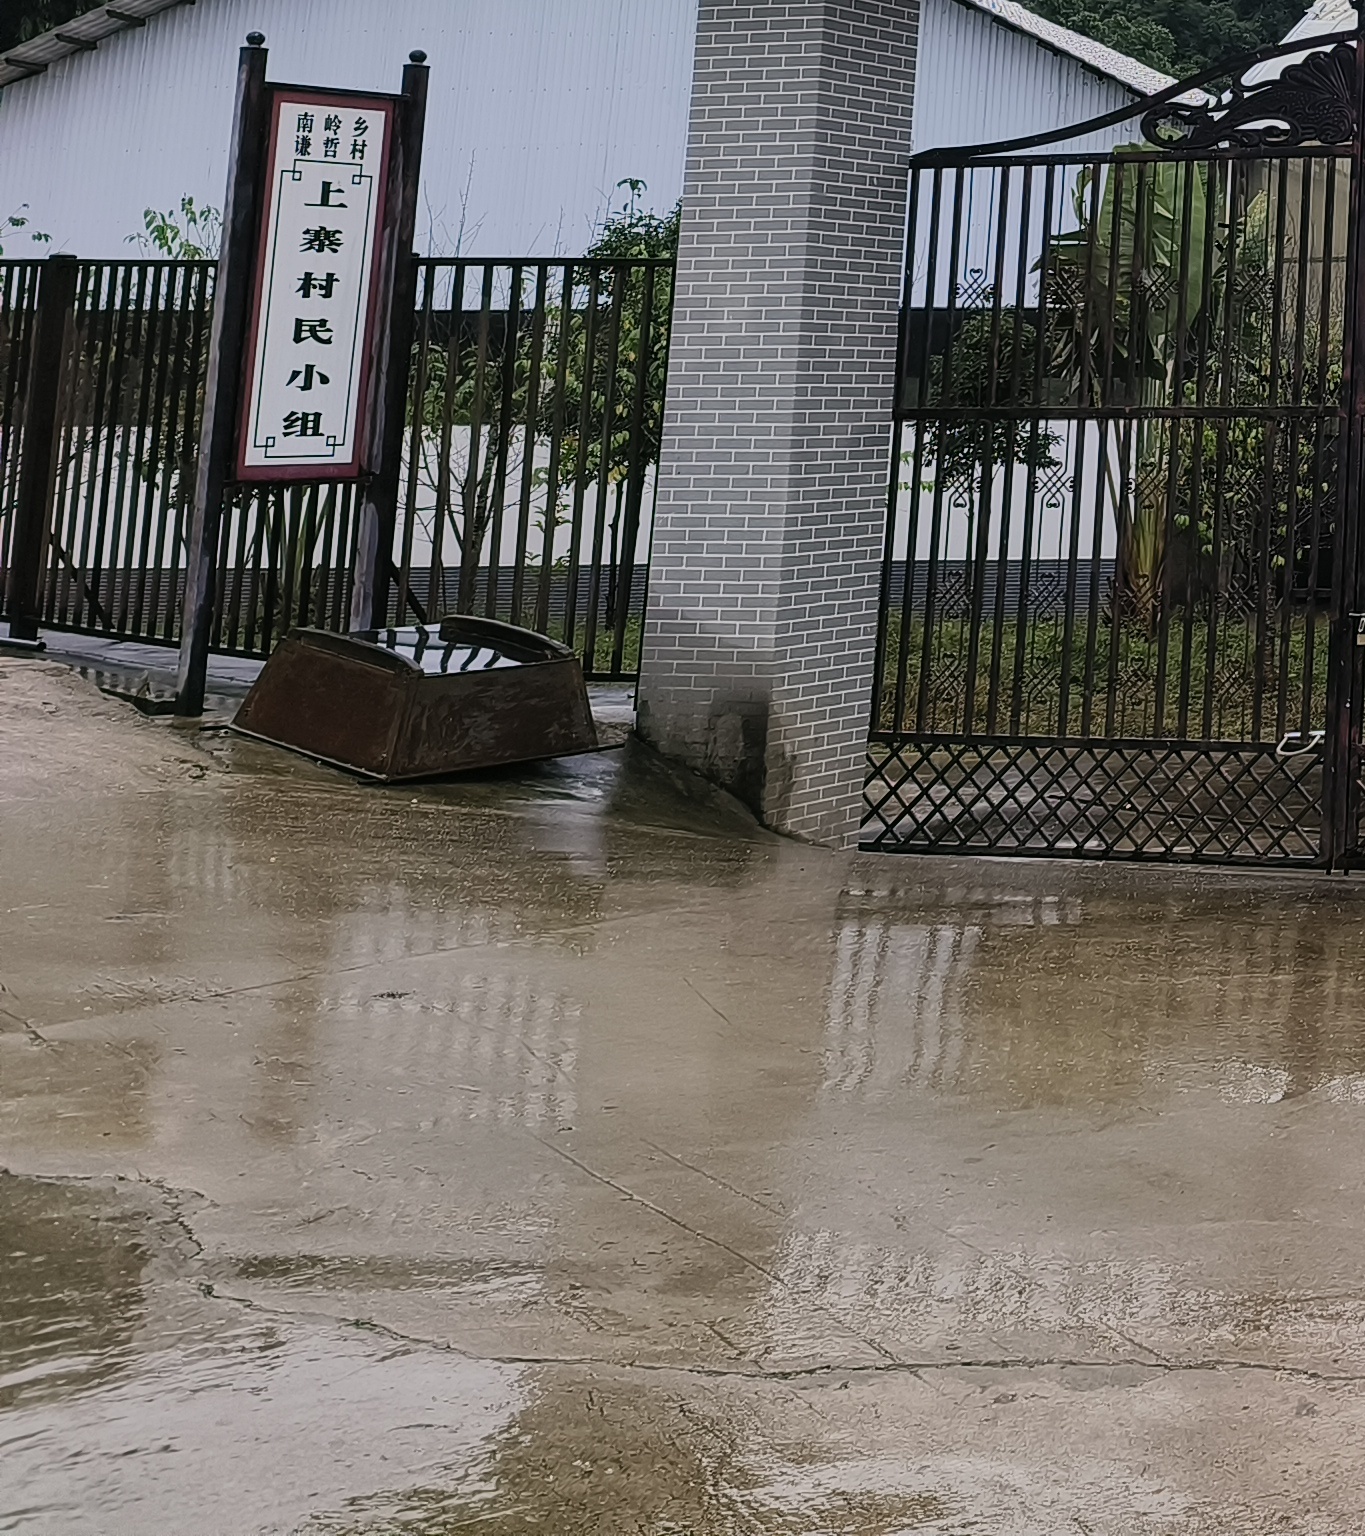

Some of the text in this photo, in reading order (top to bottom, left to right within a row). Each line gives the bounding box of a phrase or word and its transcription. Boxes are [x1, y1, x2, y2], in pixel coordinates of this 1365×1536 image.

[296, 111, 369, 138] 南岭乡
[294, 134, 368, 160] 谦哲村
[282, 180, 348, 438] 上寨村民小组
